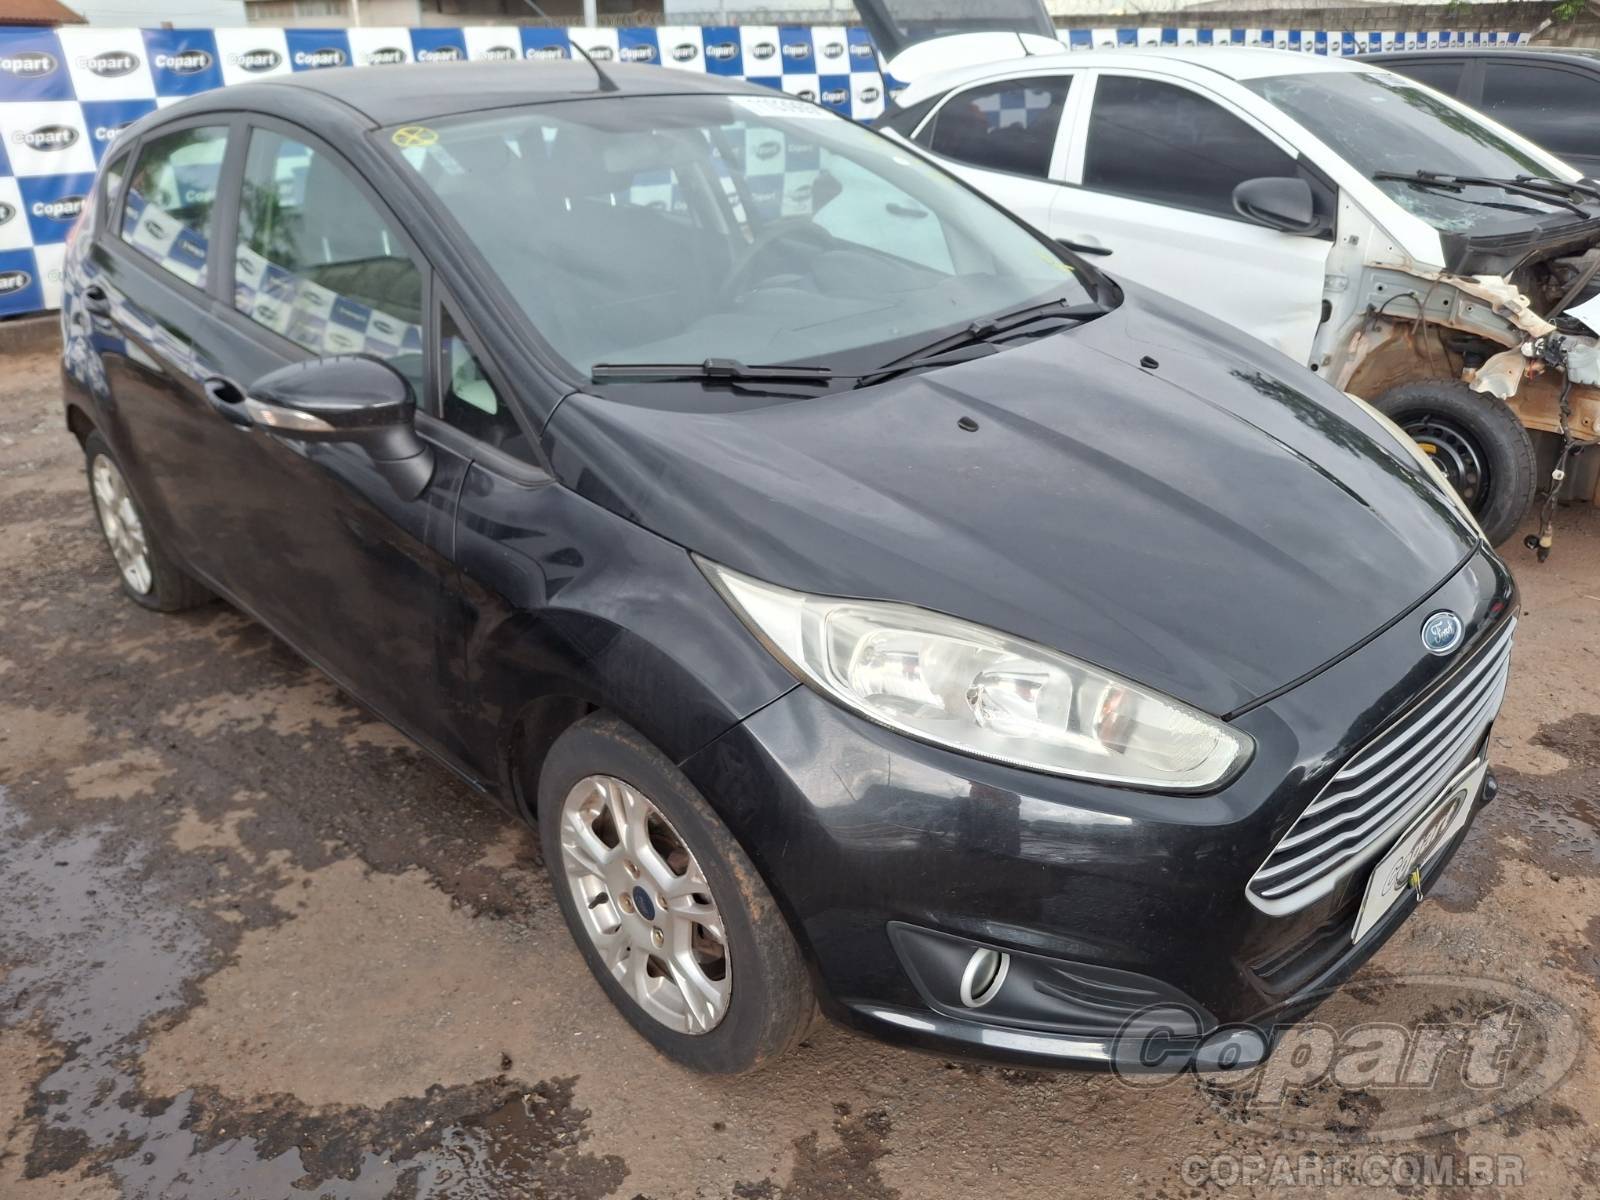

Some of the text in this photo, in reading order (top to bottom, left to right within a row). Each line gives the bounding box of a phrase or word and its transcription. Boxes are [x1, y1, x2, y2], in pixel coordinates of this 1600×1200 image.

[621, 47, 652, 60] Copart
[706, 45, 735, 57] Copart
[0, 57, 49, 73] opart
[155, 54, 207, 70] Copart
[295, 51, 340, 67] Copart
[12, 130, 70, 145] Copart
